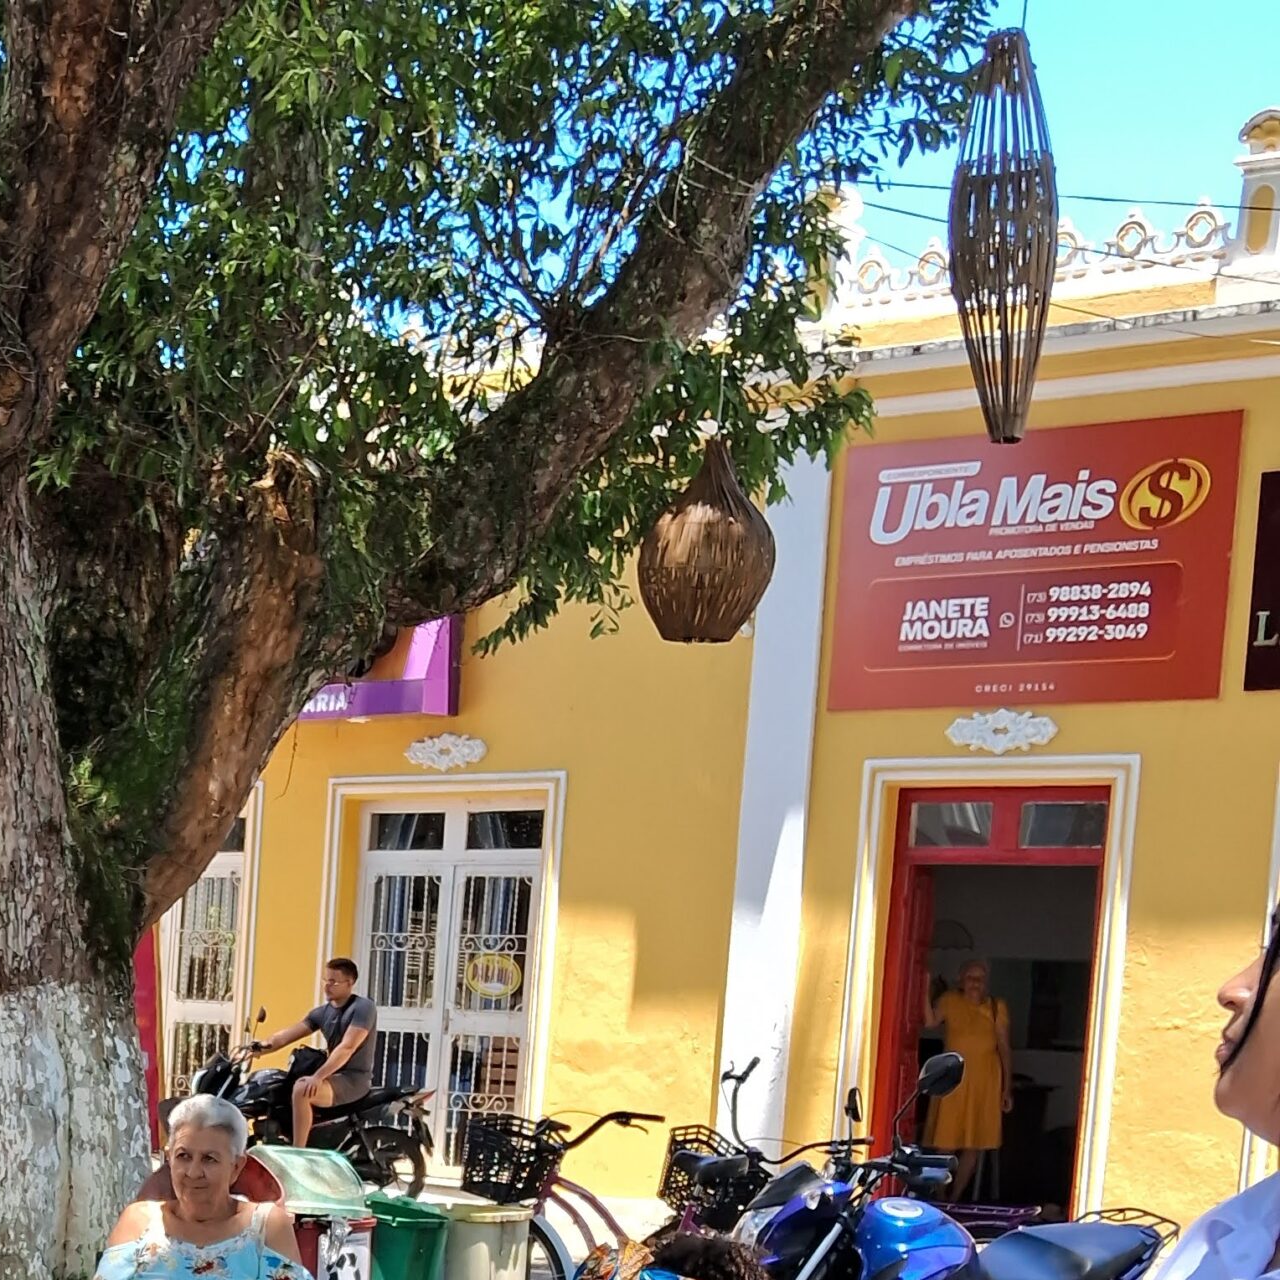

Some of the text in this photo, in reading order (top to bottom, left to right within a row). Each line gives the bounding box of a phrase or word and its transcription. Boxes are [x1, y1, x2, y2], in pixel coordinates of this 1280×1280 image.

[869, 479, 989, 545] Ubla
[991, 469, 1117, 526] Mais
[1045, 523, 1057, 533] DE
[1060, 519, 1095, 531] VENDAS
[966, 550, 993, 561] PARA
[995, 544, 1071, 560] APOSENTADOS
[1073, 544, 1082, 555] E
[1083, 539, 1159, 554] PENSIONISTAS
[1049, 581, 1151, 602] 98838-2894
[902, 596, 990, 621] JANETE
[1047, 602, 1150, 622] 99913-6488
[899, 617, 990, 641] MOURA
[1045, 623, 1148, 643] 99292-3049
